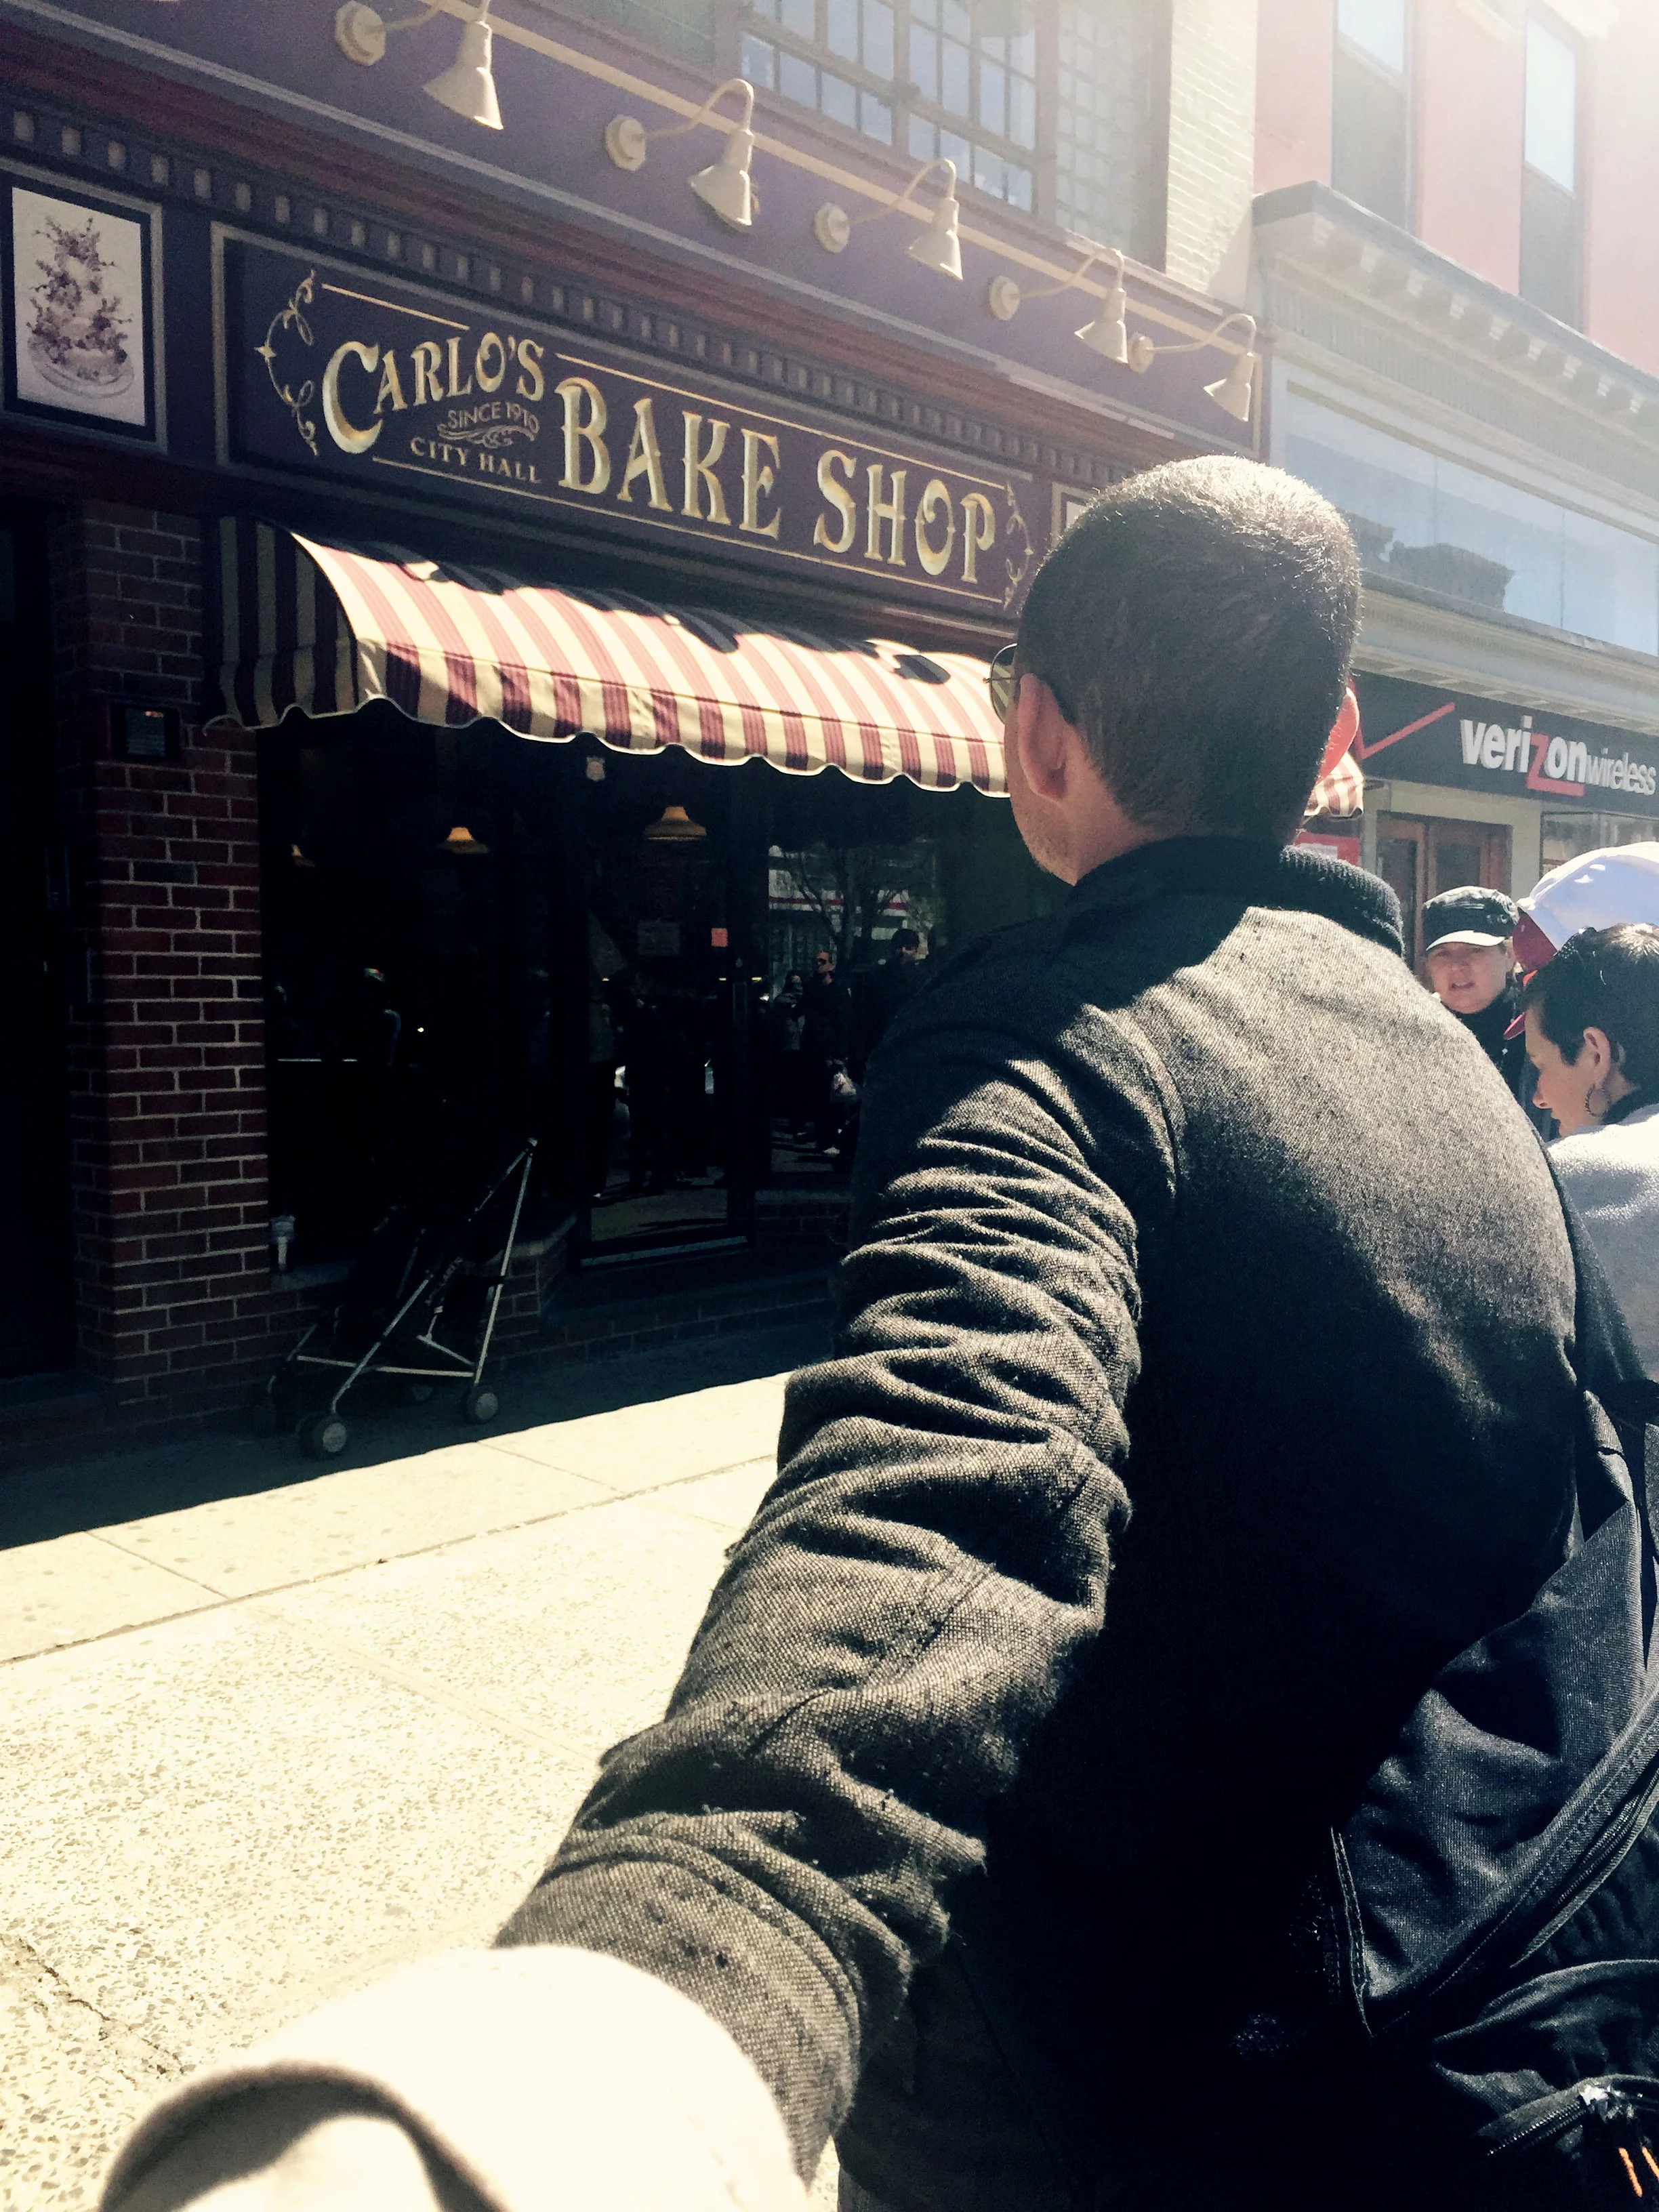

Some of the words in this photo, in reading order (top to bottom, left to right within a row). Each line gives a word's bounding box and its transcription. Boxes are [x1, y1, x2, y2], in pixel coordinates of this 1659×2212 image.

[447, 401, 501, 429] SINCE
[322, 332, 544, 454] CARLO'S
[554, 377, 781, 540] BAKE
[813, 449, 995, 584] SHOP
[410, 436, 469, 466] CITY
[478, 452, 541, 483] HALL
[1460, 715, 1586, 797] verizon
[1586, 747, 1658, 796] wireless
